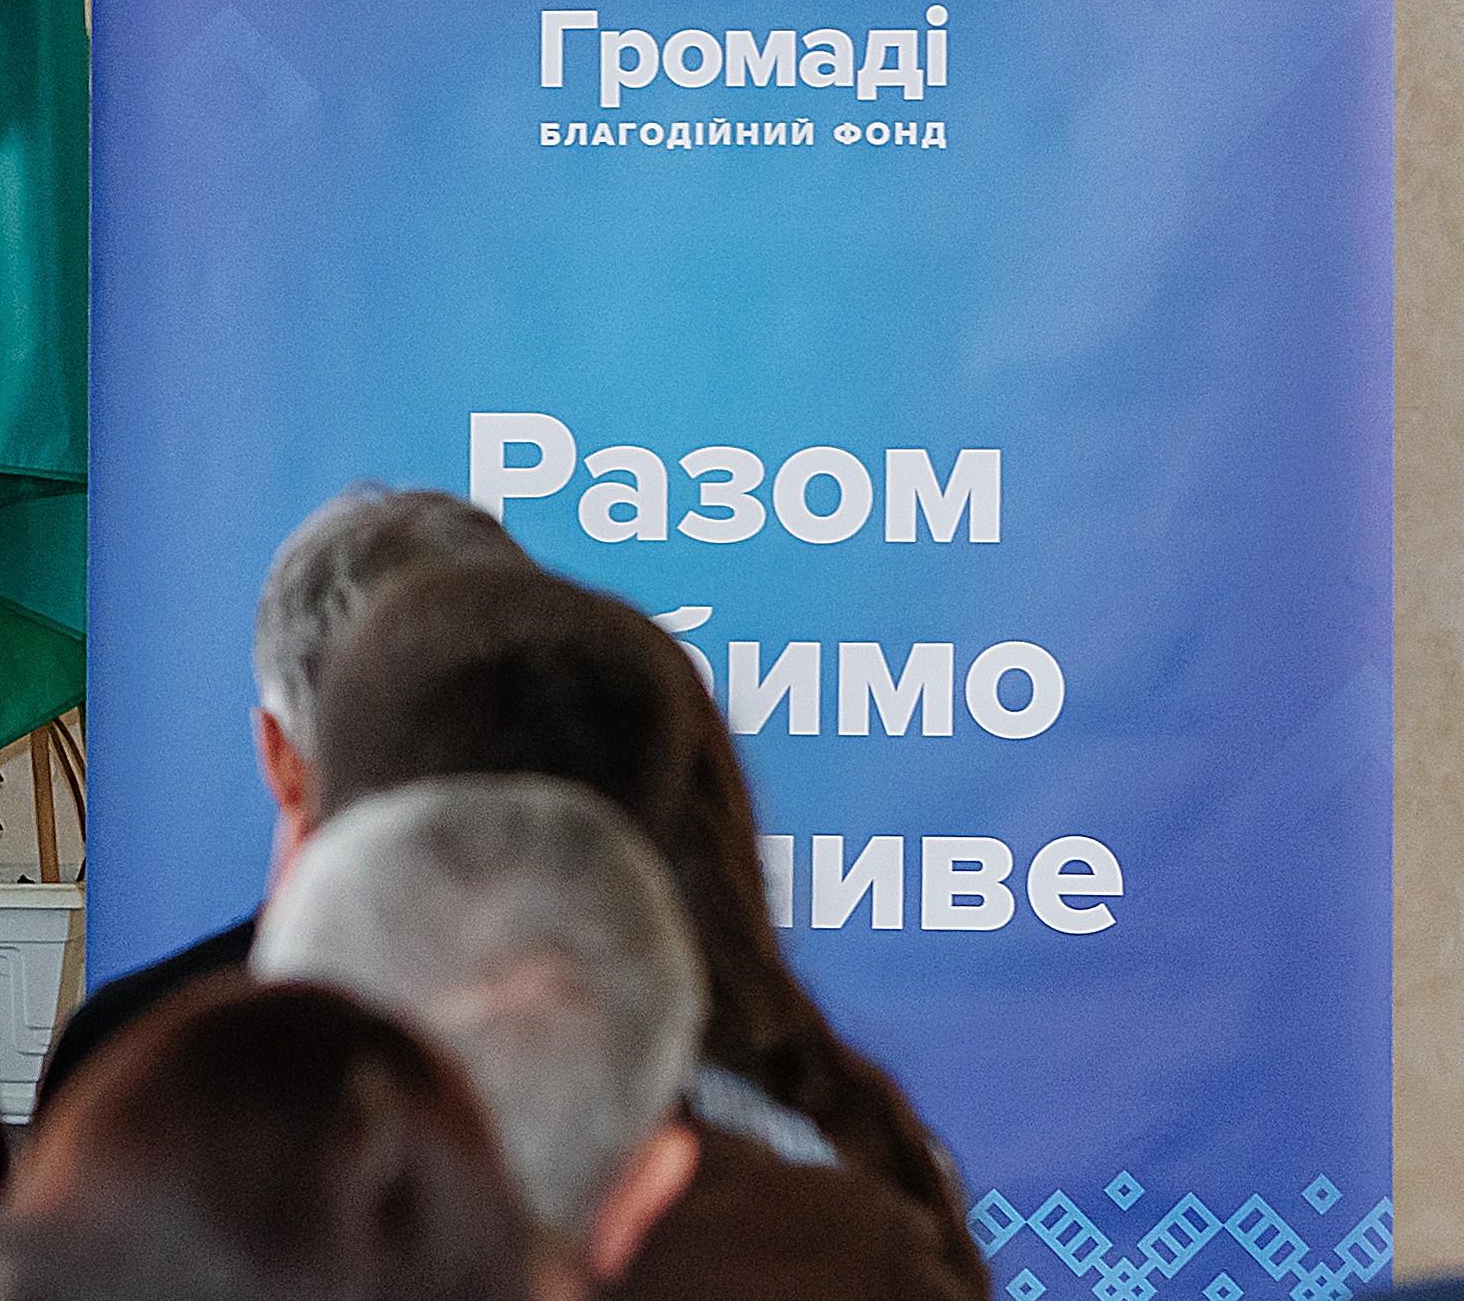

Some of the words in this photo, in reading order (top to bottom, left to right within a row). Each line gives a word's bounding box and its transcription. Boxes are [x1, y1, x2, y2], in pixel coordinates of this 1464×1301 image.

[540, 4, 948, 109] Громаді
[540, 119, 814, 149] БЛАГОДІЙНИЙ
[834, 119, 947, 149] ФОНД
[469, 411, 1002, 544] Разом
[655, 606, 1065, 739] имо
